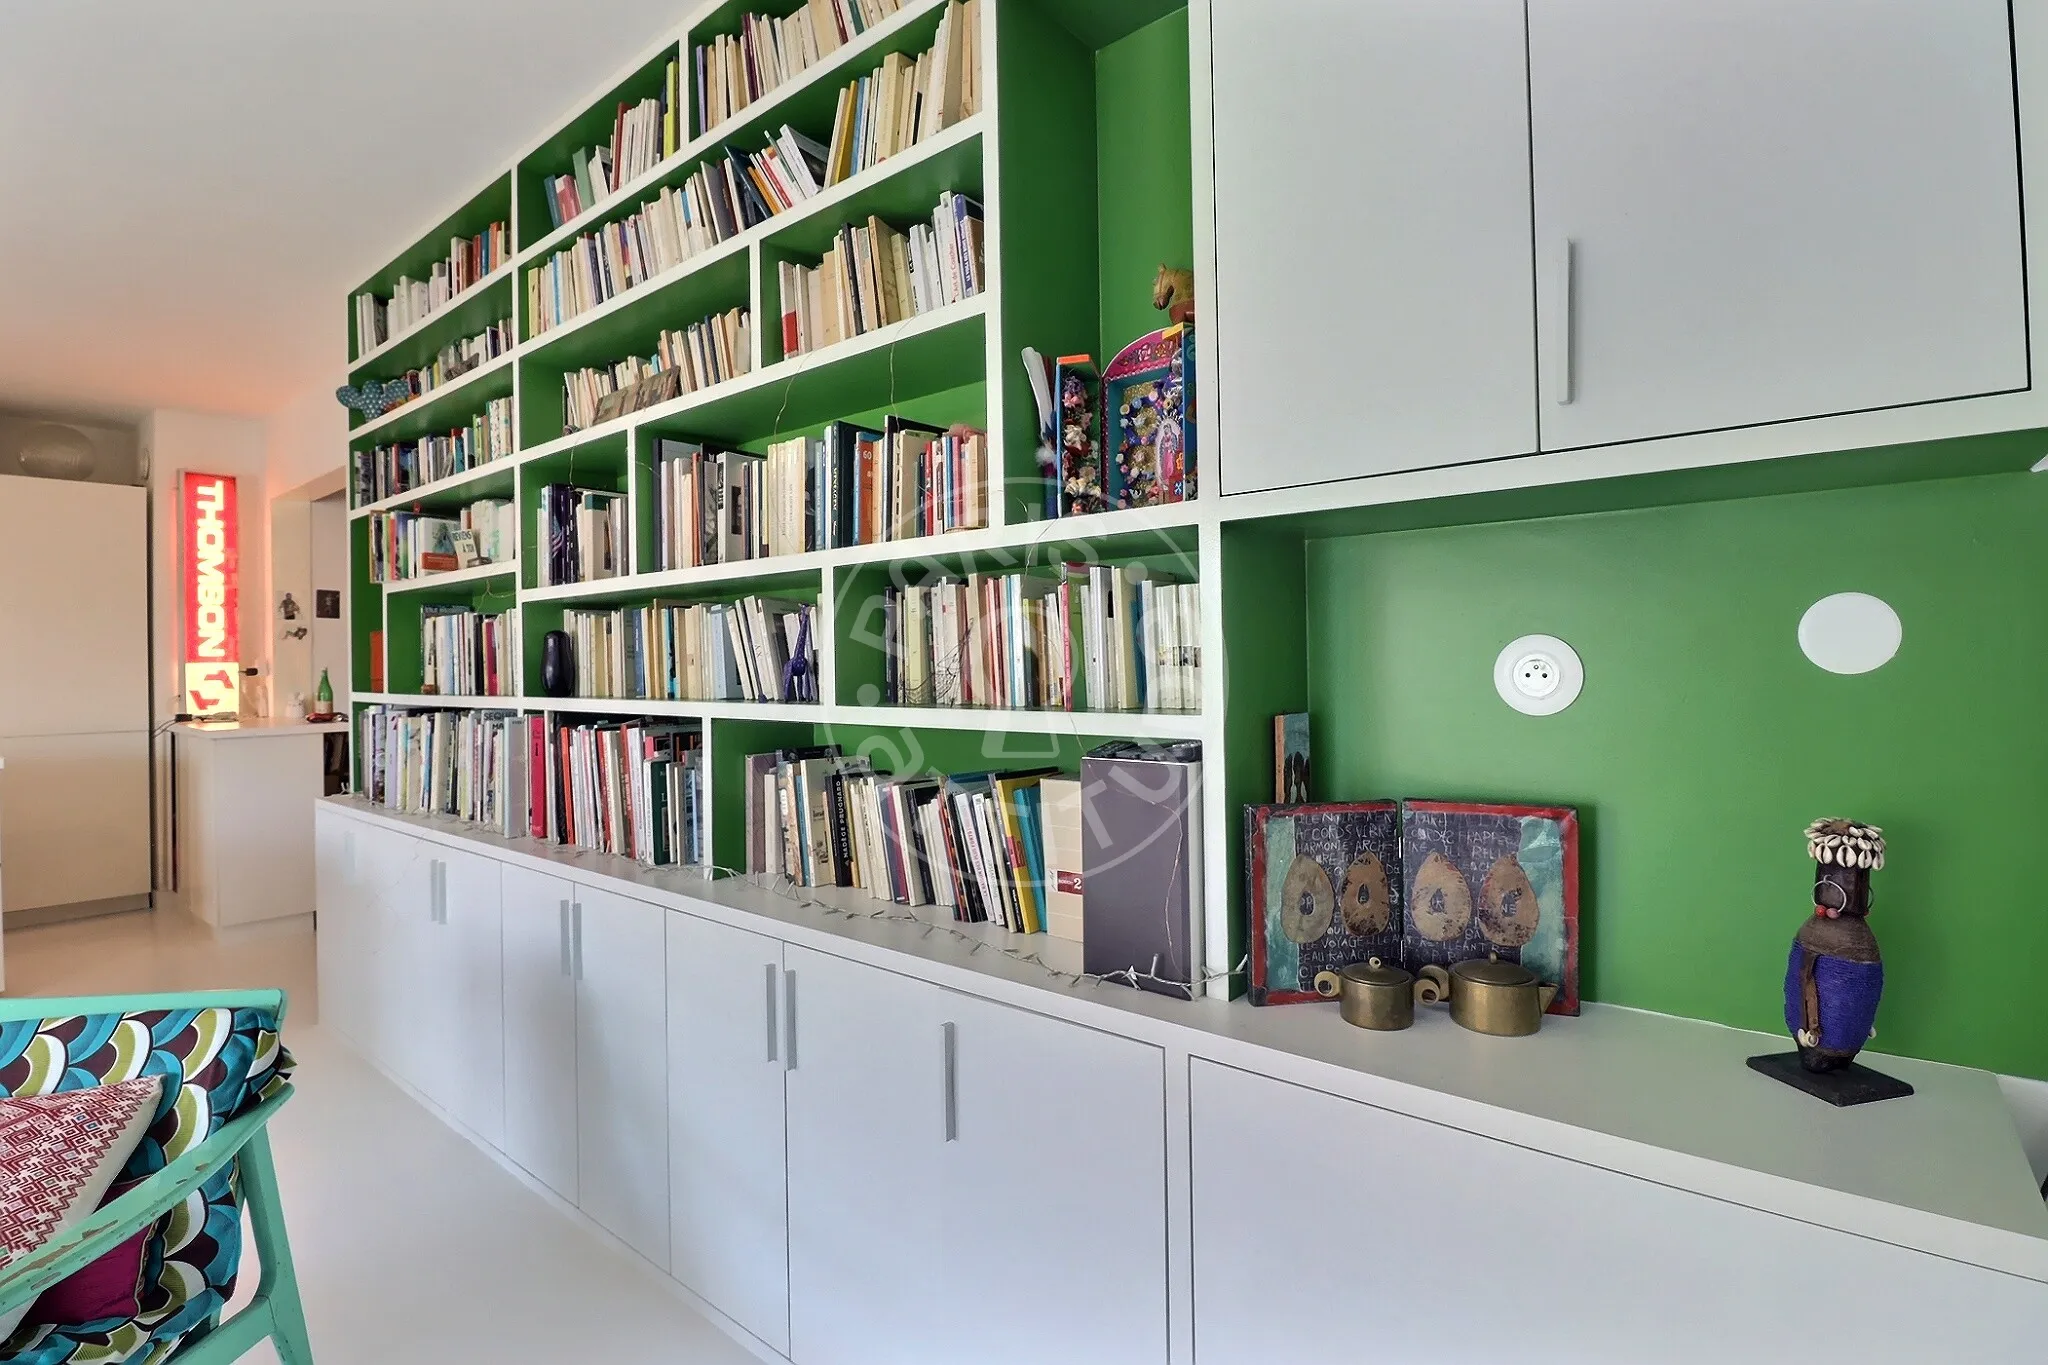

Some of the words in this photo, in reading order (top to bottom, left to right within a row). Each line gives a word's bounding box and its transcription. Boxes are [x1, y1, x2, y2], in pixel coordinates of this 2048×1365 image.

[197, 480, 225, 658] THOMSON
[836, 780, 845, 824] PRUGNARD
[1073, 877, 1082, 890] 2
